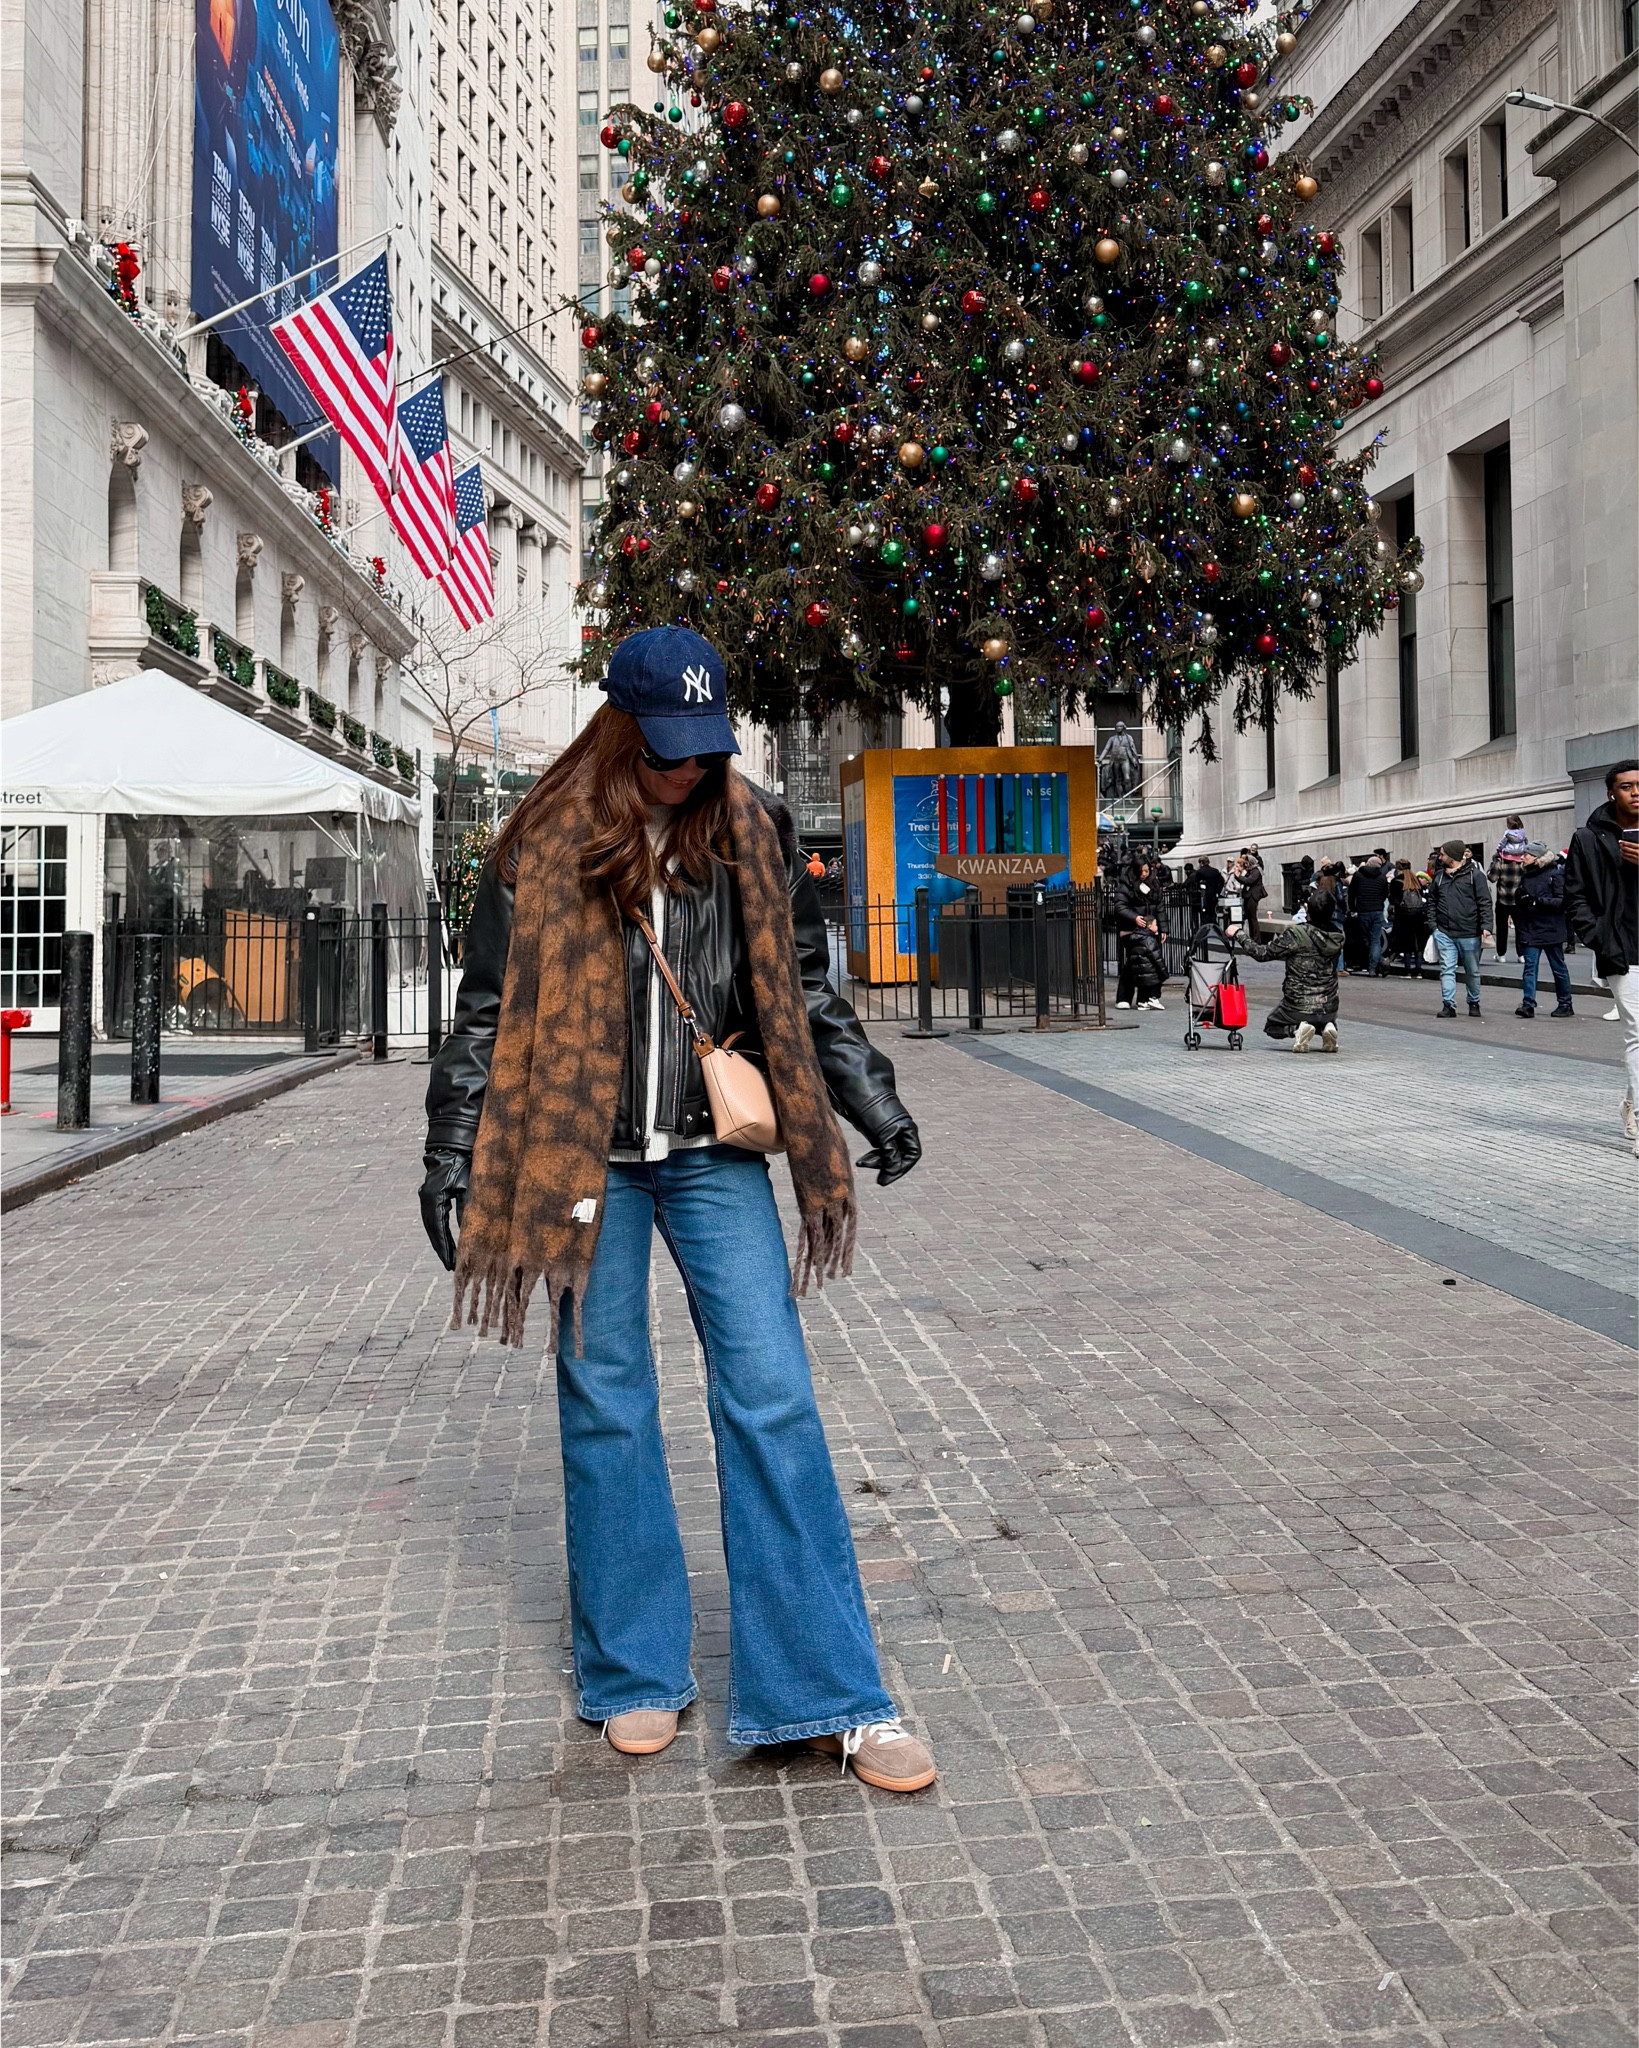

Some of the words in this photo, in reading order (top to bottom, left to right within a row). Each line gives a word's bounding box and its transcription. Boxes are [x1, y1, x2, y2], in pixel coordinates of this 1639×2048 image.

[257, 71, 275, 122] TRADE
[275, 109, 285, 145] THE
[286, 132, 302, 178] TITANS
[212, 150, 232, 194] TBXU
[211, 180, 231, 215] LISTED
[238, 188, 256, 231] TEXU
[211, 200, 231, 245] NYSE
[237, 217, 255, 251] LISTED
[237, 238, 255, 282] NYSE
[261, 225, 277, 266] TSXU
[682, 664, 713, 703] NY
[0, 791, 43, 805] treet
[1027, 787, 1052, 796] NSE
[908, 822, 930, 832] Tree
[957, 858, 1047, 875] KWANZAA
